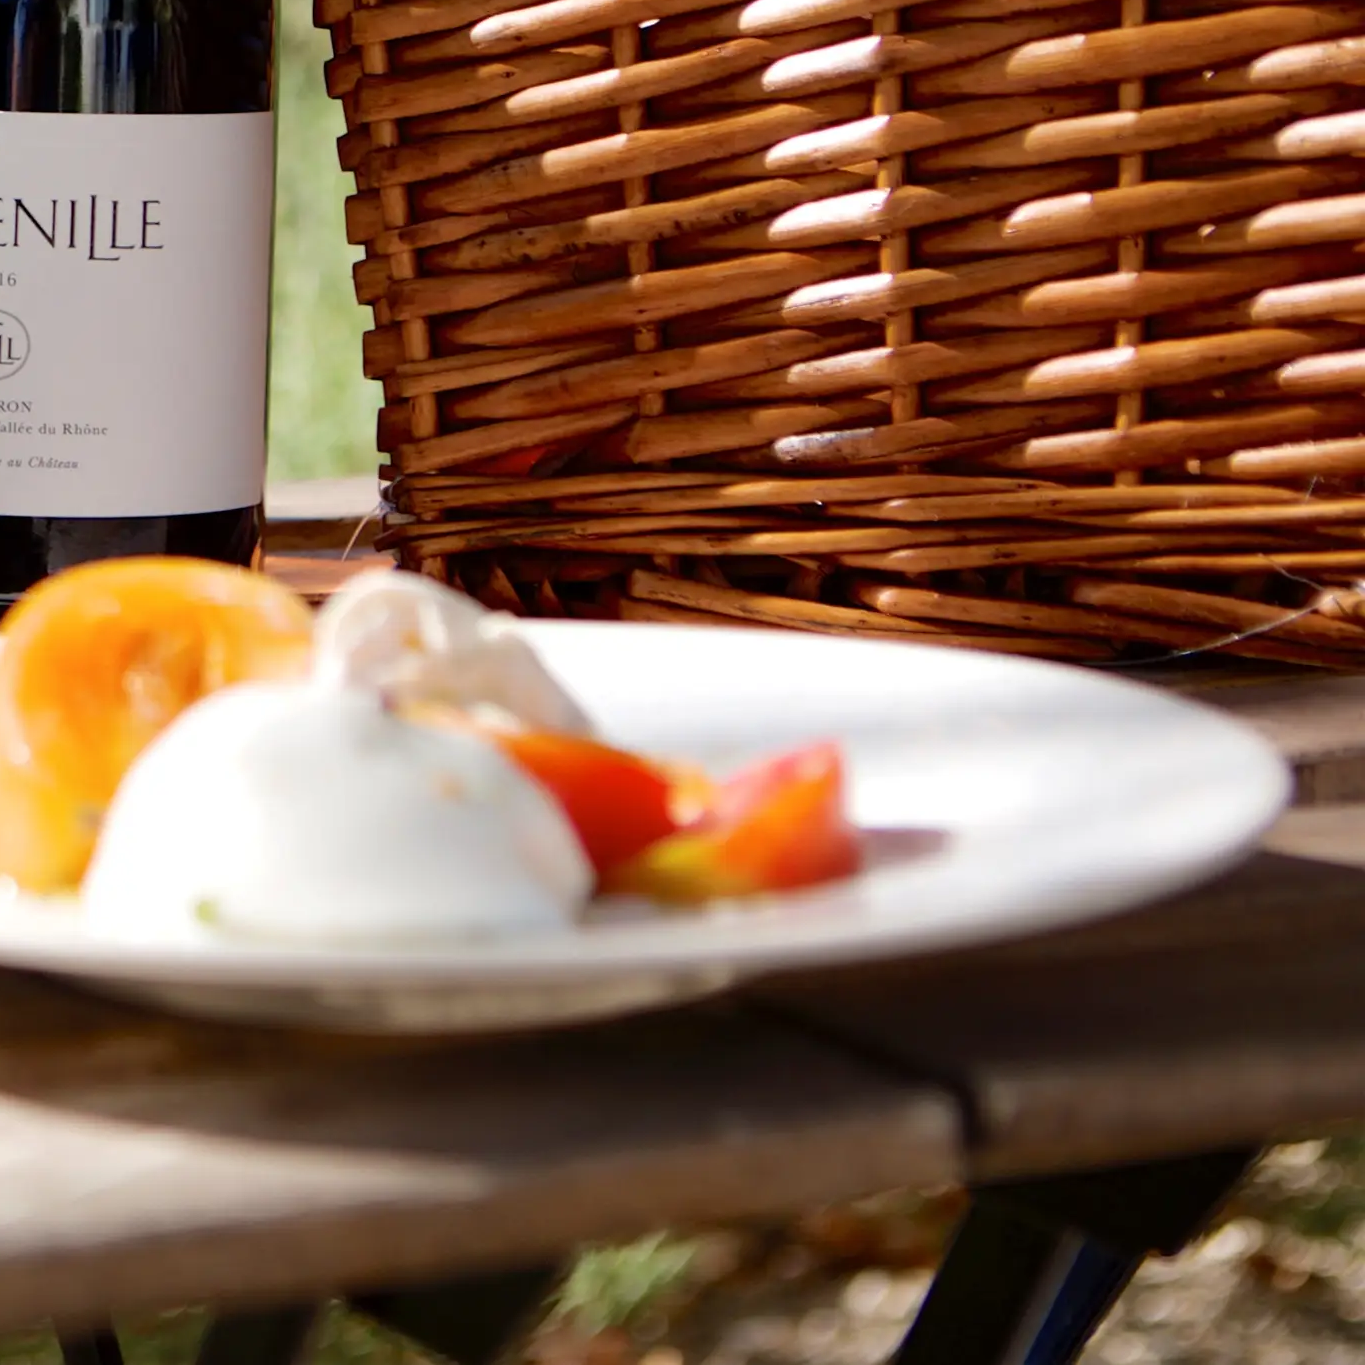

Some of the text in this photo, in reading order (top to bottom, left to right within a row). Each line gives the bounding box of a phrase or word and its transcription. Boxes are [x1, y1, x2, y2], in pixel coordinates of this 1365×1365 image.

[38, 422, 56, 435] du
[62, 423, 109, 436] Rhône
[7, 458, 22, 468] au
[28, 455, 79, 470] Château
